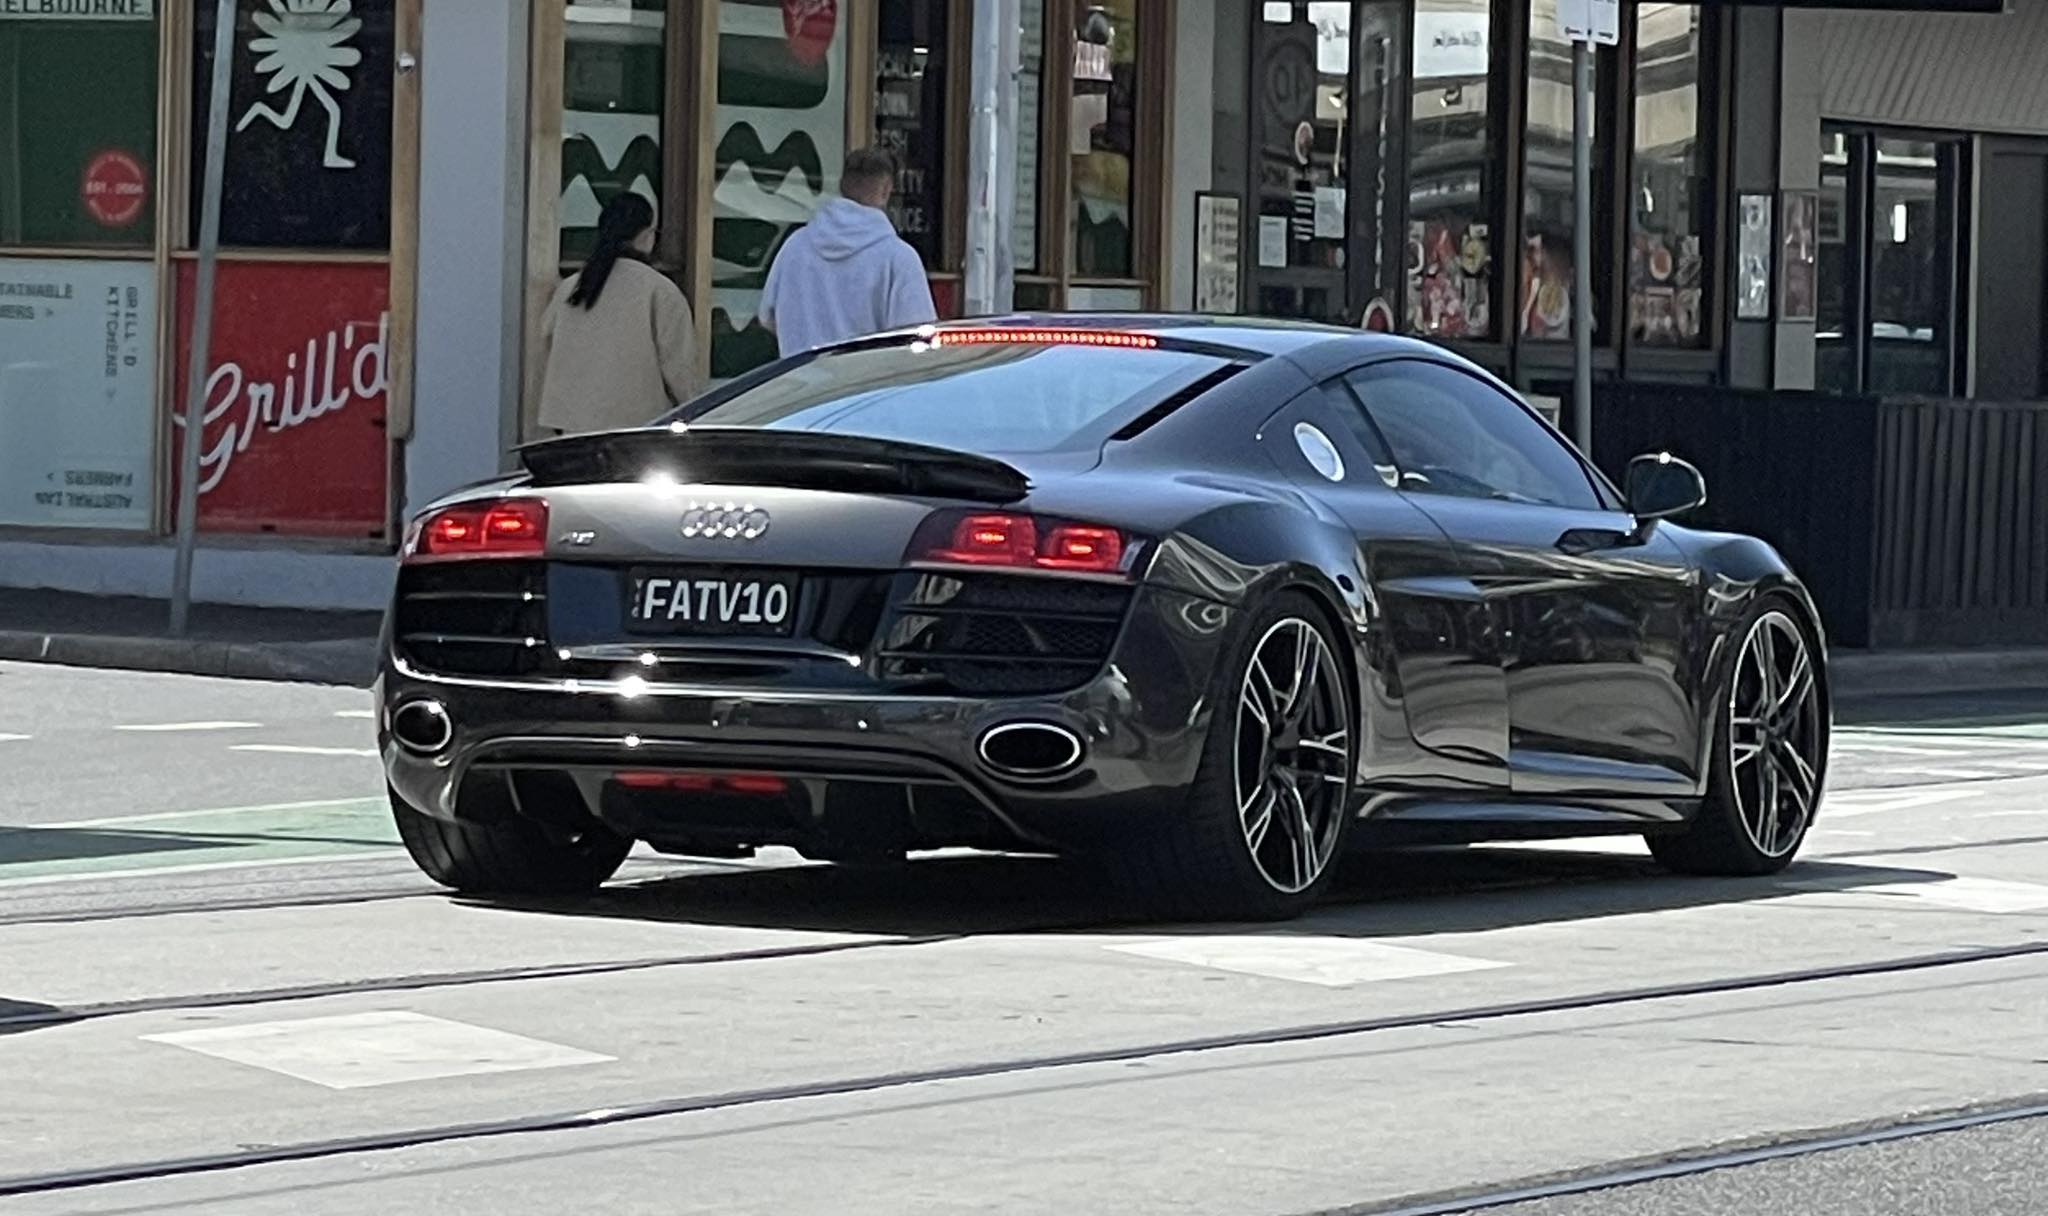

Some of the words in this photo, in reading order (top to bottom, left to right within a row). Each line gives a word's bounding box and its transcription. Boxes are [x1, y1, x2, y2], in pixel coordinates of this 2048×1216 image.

[0, 0, 149, 14] ELBOURNE
[105, 286, 119, 377] KITCHENS
[172, 310, 389, 493] Grill'd
[64, 470, 132, 487] FARMERS
[643, 579, 788, 623] FATV10
